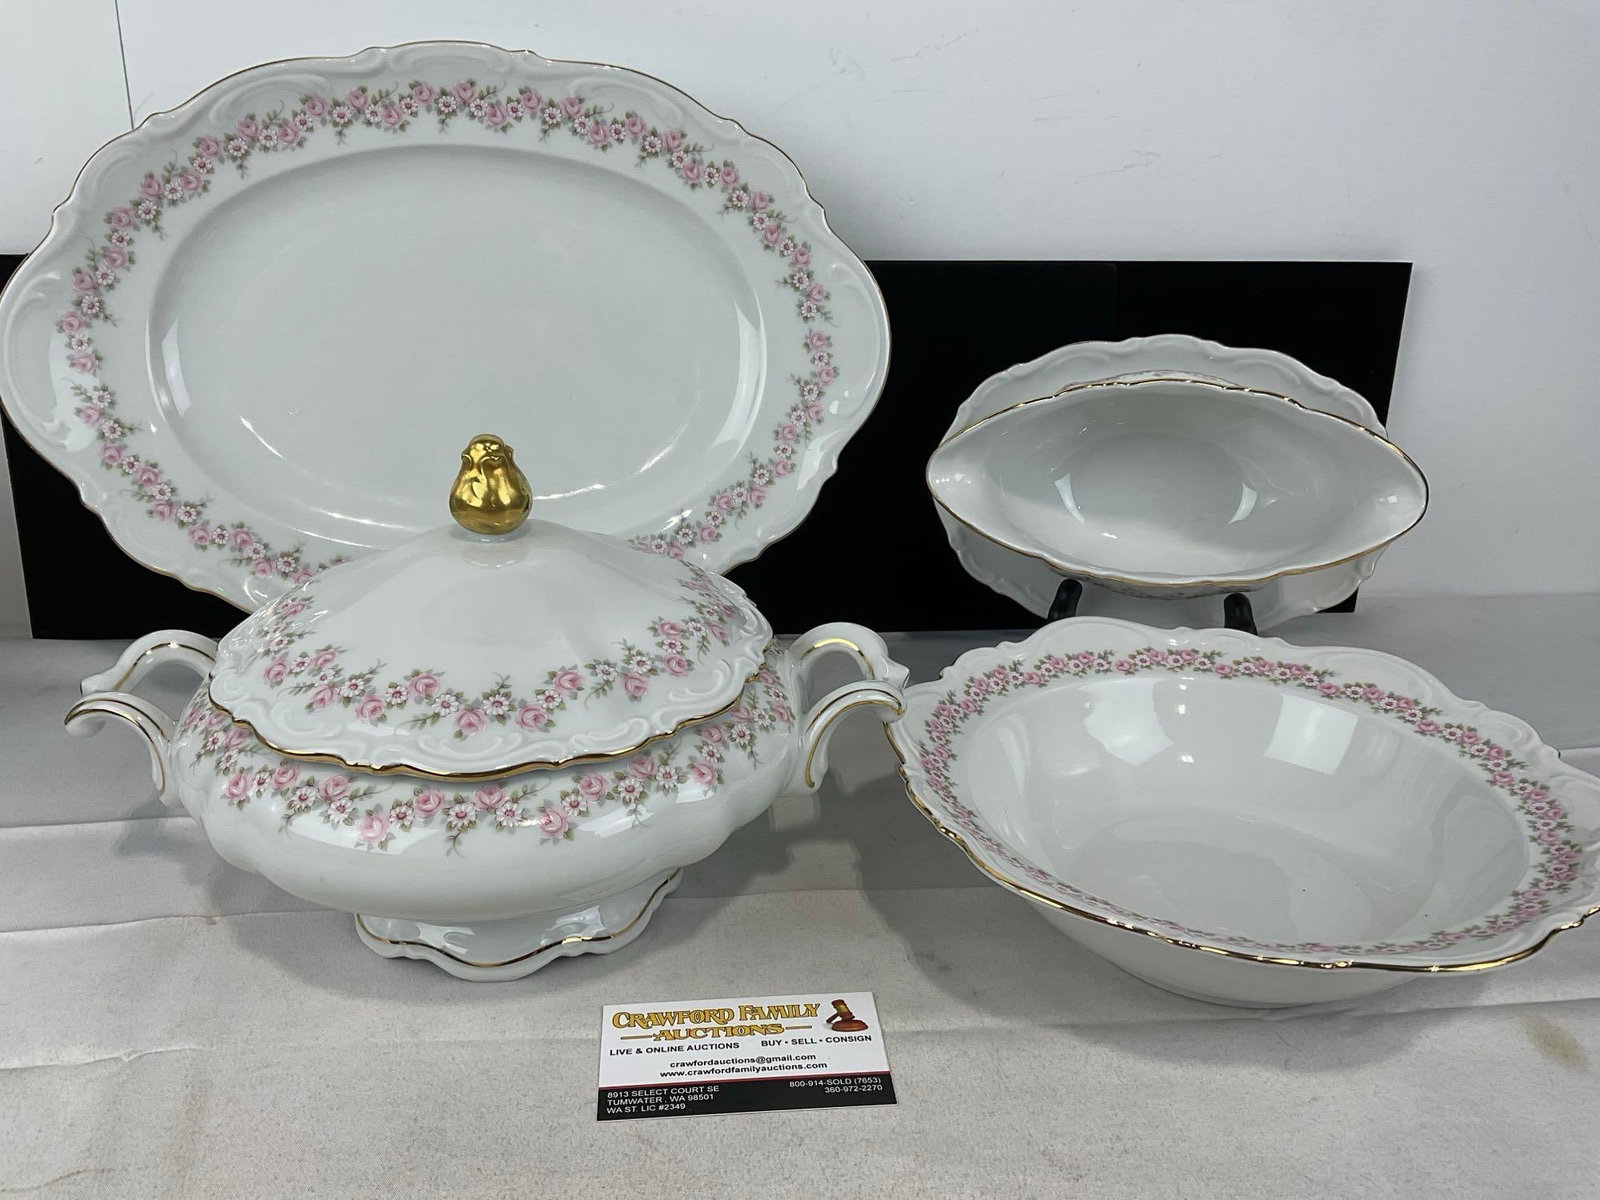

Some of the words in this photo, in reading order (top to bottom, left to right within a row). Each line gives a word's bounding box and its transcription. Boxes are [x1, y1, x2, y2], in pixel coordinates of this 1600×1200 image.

[612, 1008, 735, 1029] CRAWFORD
[738, 1004, 820, 1020] FAMILY
[653, 1023, 785, 1041] AUCTIONS
[791, 1037, 817, 1045] SELL
[825, 1035, 872, 1043] CONSIGN
[609, 1048, 633, 1056] LIVE
[645, 1045, 684, 1054] ONLINE
[686, 1042, 740, 1051] AUCTIONS
[670, 1054, 816, 1068] crawfordauctions@gmail.com
[660, 1062, 828, 1077] www.crawfordfamilyauctions.com
[789, 1079, 852, 1088] 800-914-SOLD
[853, 1077, 882, 1085] (7653)
[824, 1084, 883, 1094] 360-972-2270
[607, 1091, 629, 1099] 8913
[631, 1088, 668, 1097] SELECT
[670, 1086, 704, 1095] COURT
[687, 1093, 714, 1101] 98501
[606, 1106, 623, 1114] WA
[641, 1104, 656, 1112] LIC
[658, 1102, 686, 1111] #2349
